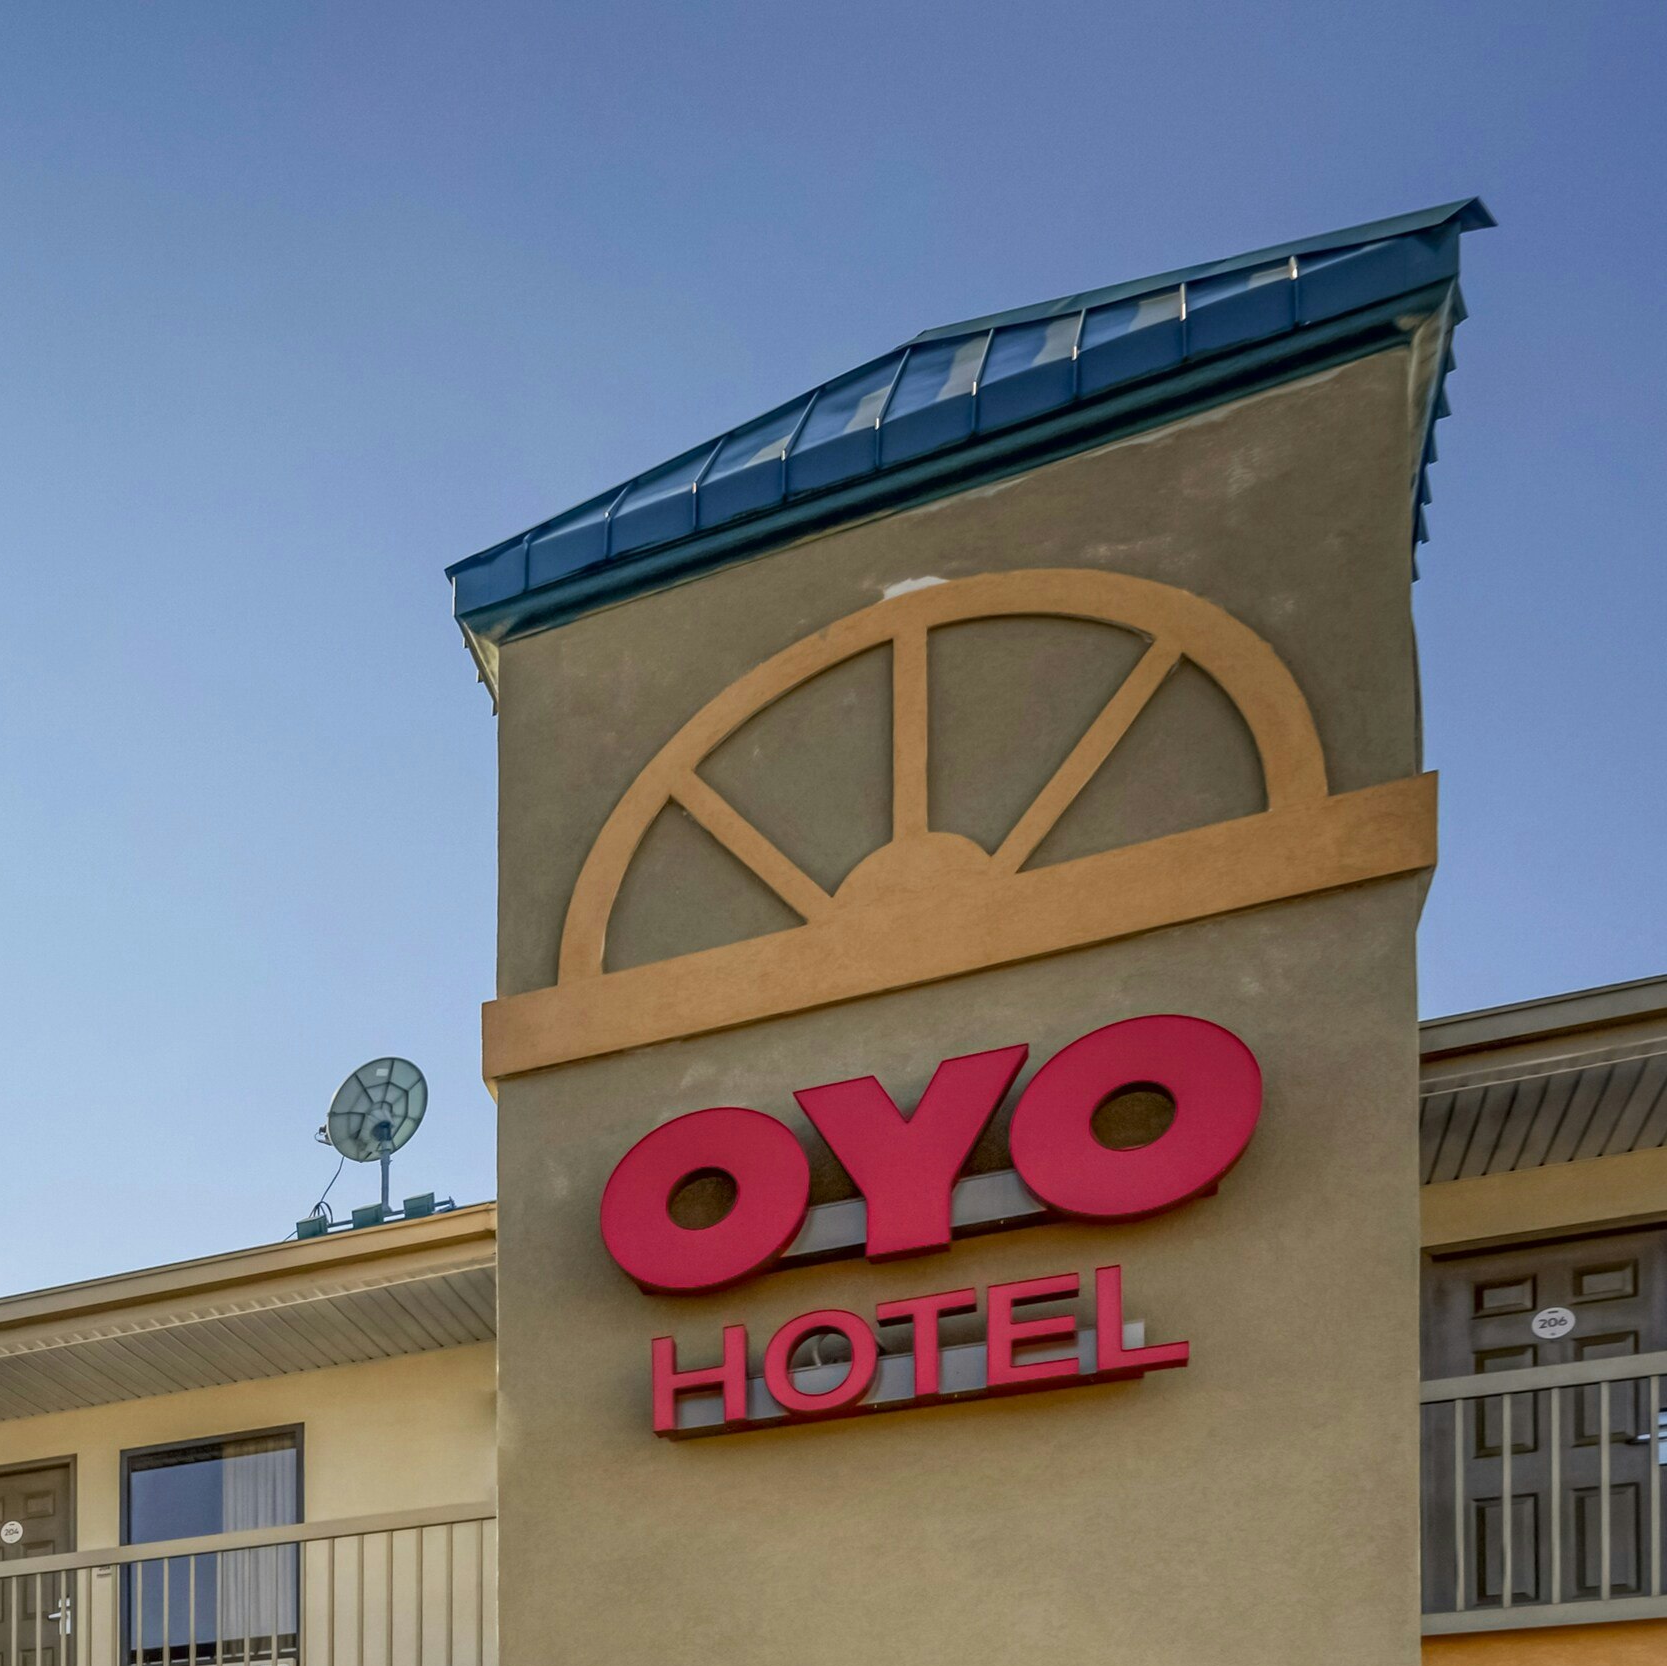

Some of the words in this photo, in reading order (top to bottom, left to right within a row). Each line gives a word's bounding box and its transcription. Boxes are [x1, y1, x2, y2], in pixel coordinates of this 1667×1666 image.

[600, 1014, 1262, 1293] OYO
[652, 1265, 1189, 1436] HOTEL
[1538, 1316, 1568, 1329] 206
